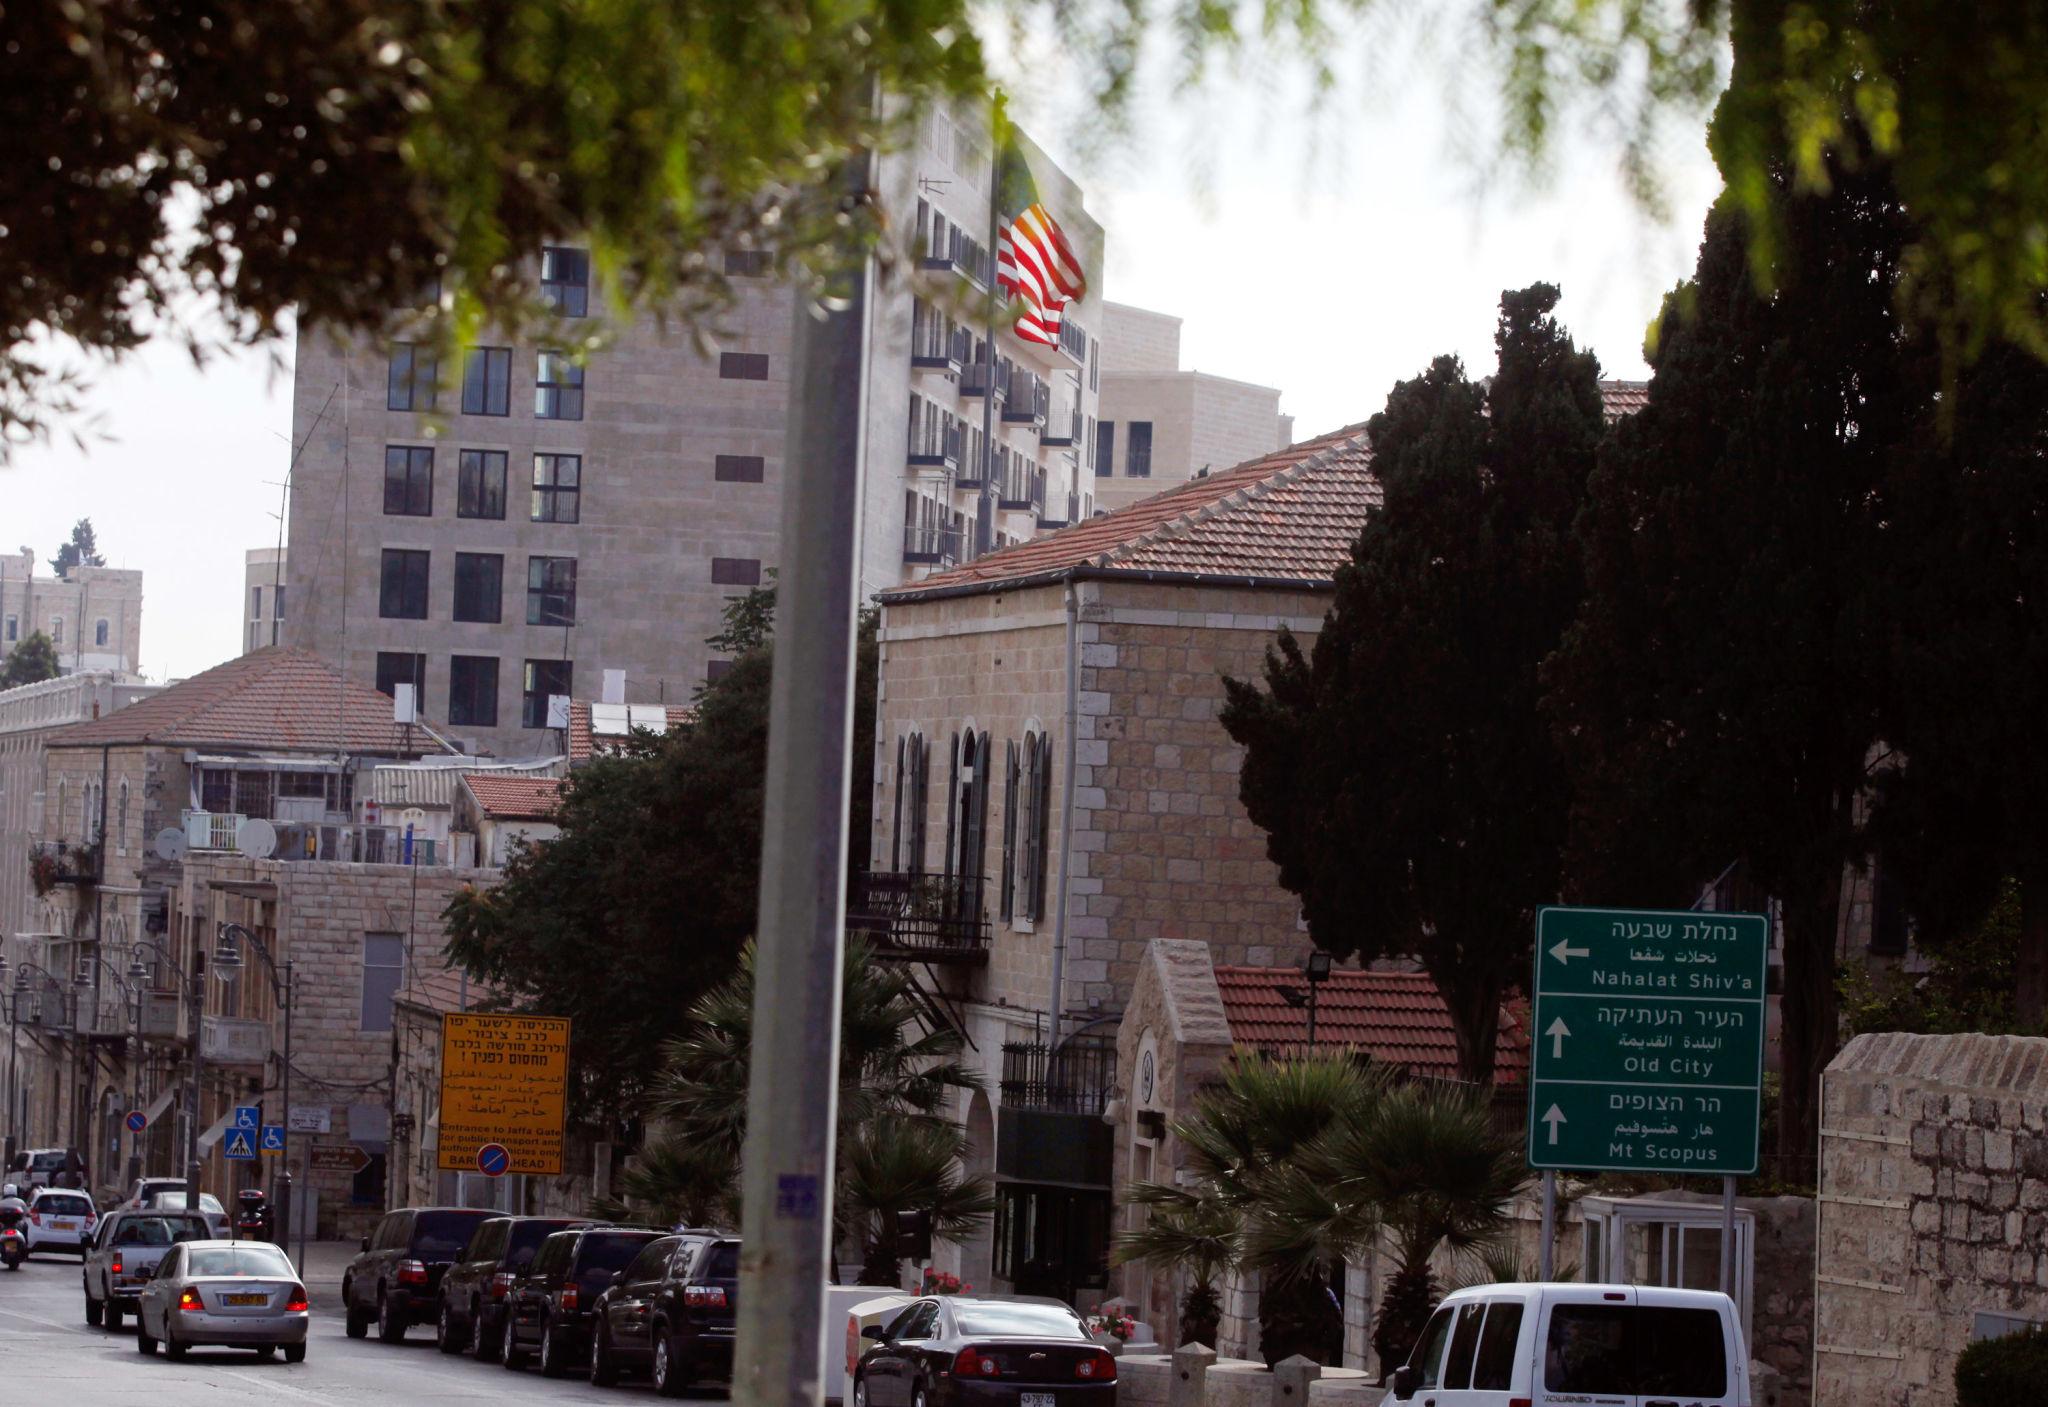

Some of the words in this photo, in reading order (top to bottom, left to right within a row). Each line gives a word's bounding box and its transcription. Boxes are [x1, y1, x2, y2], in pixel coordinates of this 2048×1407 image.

[1612, 921, 1672, 940] שבעה
[1682, 920, 1737, 941] נחלת
[1674, 950, 1717, 964] نحلات
[1592, 969, 1677, 988] Nahalat
[1689, 973, 1752, 989] Shiv'a
[450, 1017, 469, 1026] יפו
[1597, 1007, 1683, 1026] העתיקה
[1694, 1010, 1743, 1027] העיר
[517, 1020, 564, 1031] הכניסה
[515, 1030, 548, 1042] לרכב
[1618, 1033, 1672, 1050] القديمة
[1683, 1036, 1722, 1052] البلدة
[509, 1053, 548, 1066] מחסום
[1624, 1056, 1659, 1073] Old
[1670, 1058, 1714, 1078] City
[1610, 1094, 1684, 1112] הצופים
[1695, 1097, 1721, 1113] הר
[440, 1122, 490, 1132] Entrance
[494, 1126, 504, 1134] to
[508, 1126, 532, 1135] Jaffa
[536, 1128, 560, 1136] Gate
[1692, 1122, 1714, 1139] هار
[440, 1132, 456, 1141] for
[458, 1134, 490, 1144] public
[492, 1136, 540, 1146] transport
[542, 1138, 560, 1146] and
[540, 1150, 560, 1158] only
[1609, 1143, 1633, 1158] Mt
[1646, 1144, 1718, 1163] Scopus
[510, 1158, 546, 1168] HEAD
